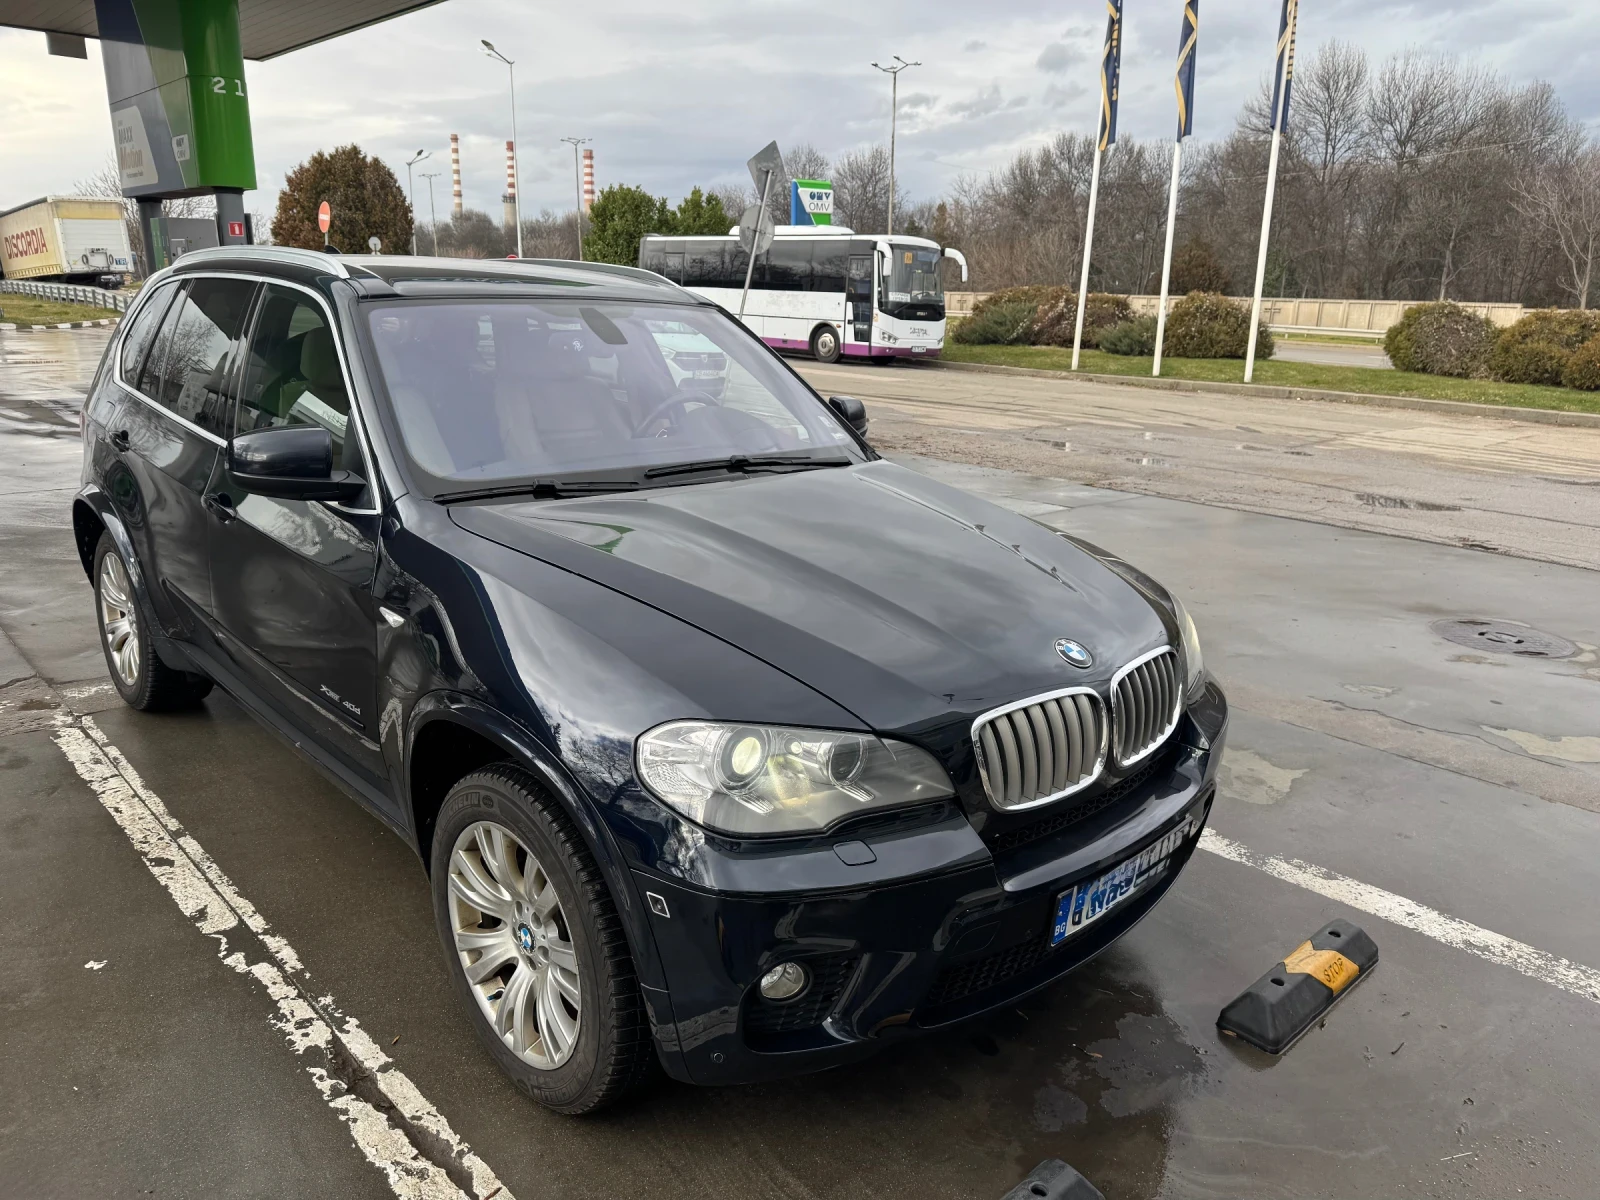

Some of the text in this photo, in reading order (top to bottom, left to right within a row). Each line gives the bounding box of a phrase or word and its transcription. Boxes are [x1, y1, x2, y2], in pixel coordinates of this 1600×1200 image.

[213, 76, 245, 97] 2 1
[808, 202, 830, 212] OMV
[4, 227, 48, 260] DISCORDIA
[1054, 921, 1067, 935] BG
[1323, 956, 1345, 984] STOP
